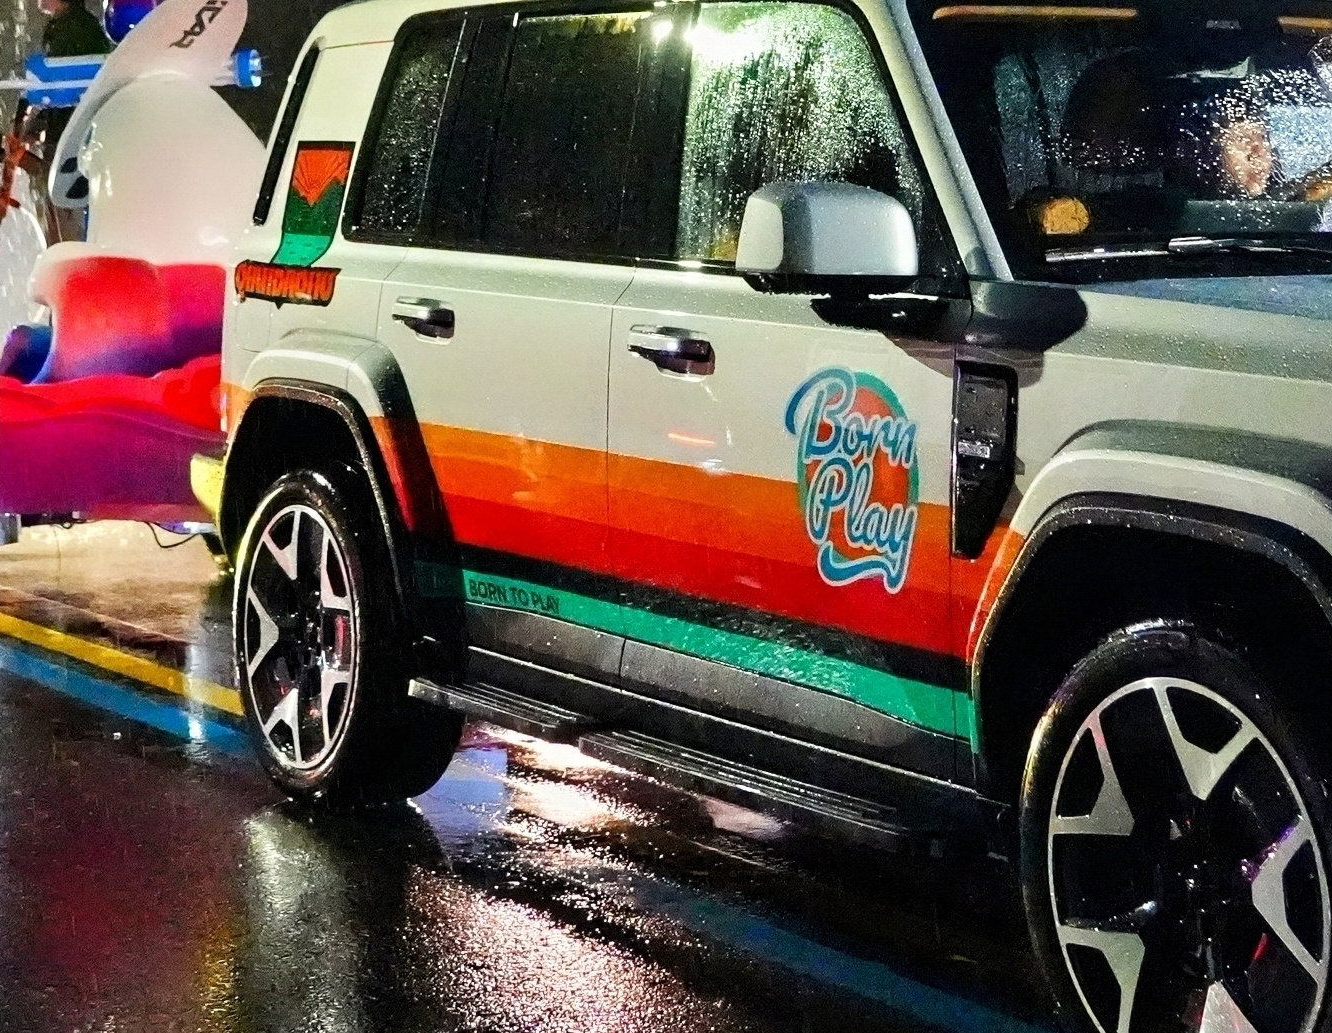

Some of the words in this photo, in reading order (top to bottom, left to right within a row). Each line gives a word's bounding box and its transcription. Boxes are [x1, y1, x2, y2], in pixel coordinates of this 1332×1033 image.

[784, 367, 918, 466] Born
[807, 456, 918, 594] Play
[469, 579, 508, 602] BORN
[509, 586, 529, 606] TO
[530, 591, 561, 614] PLAY
